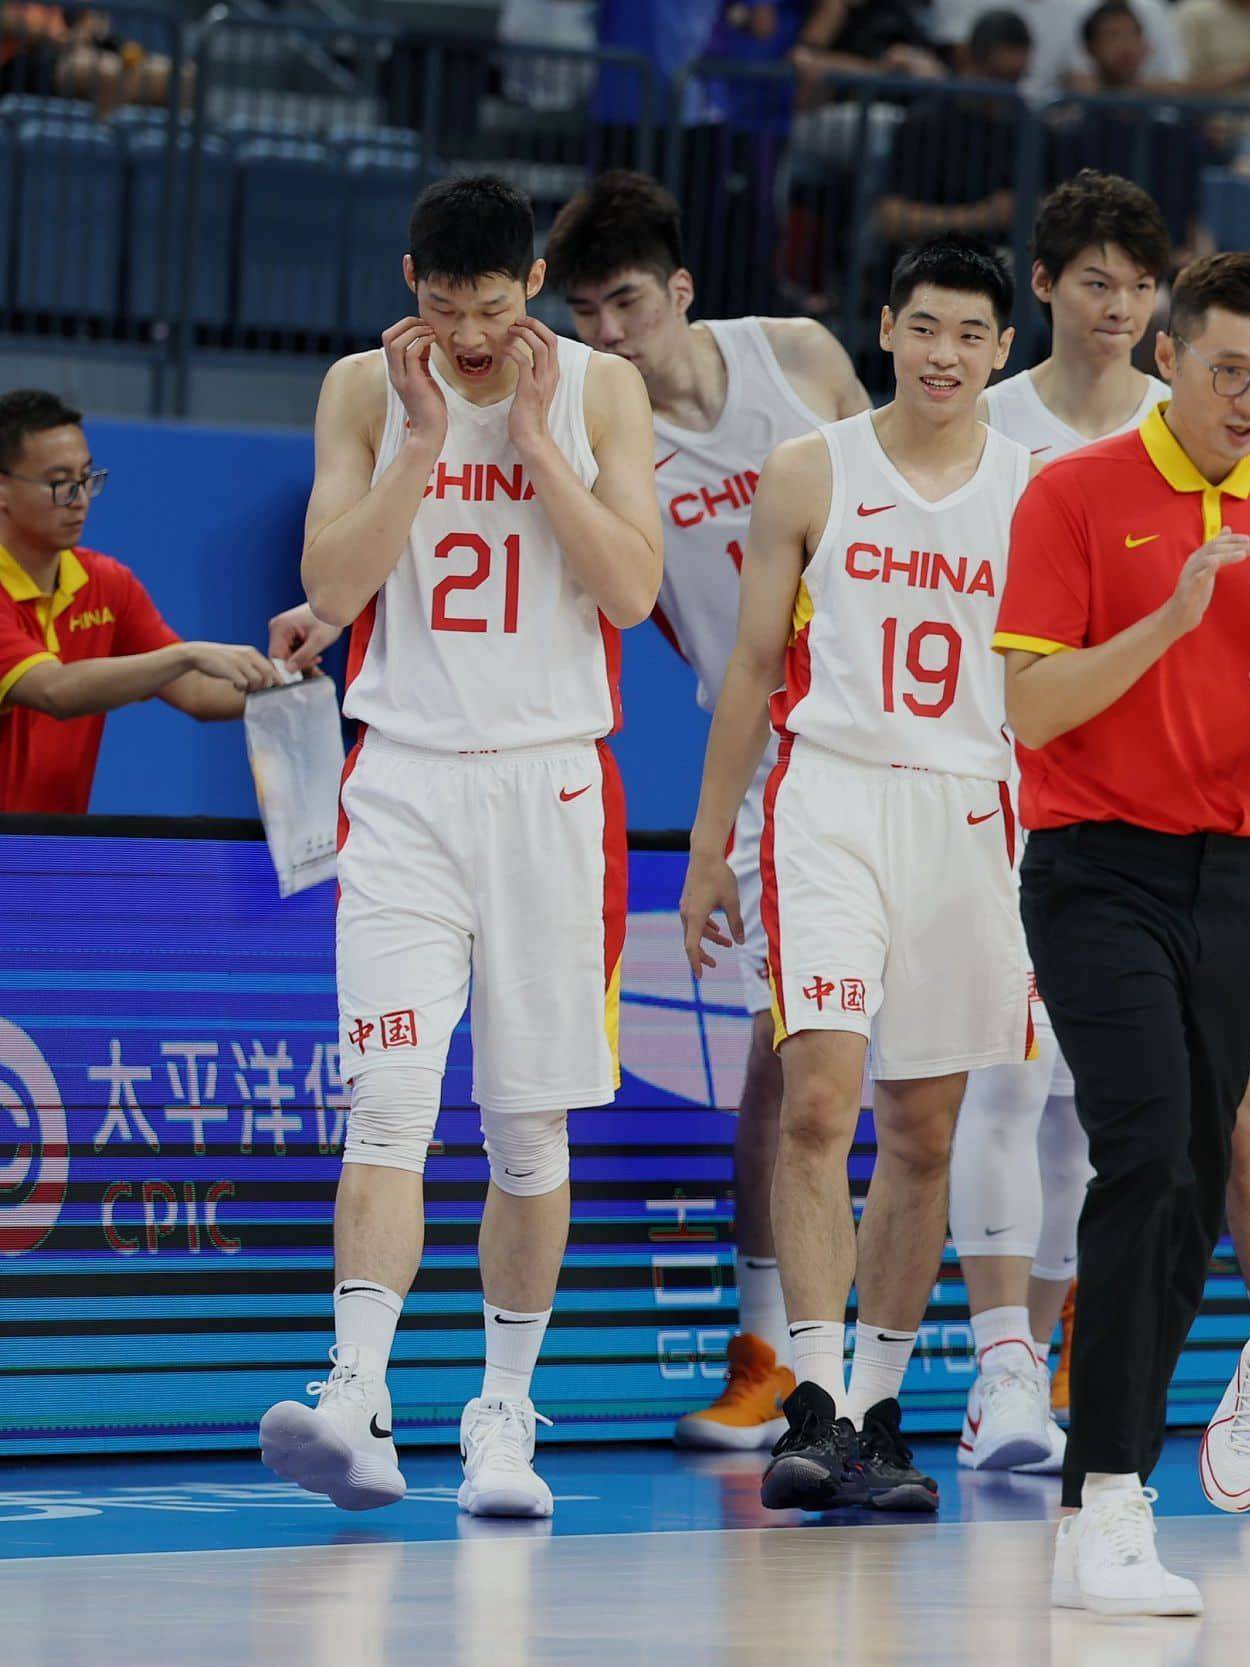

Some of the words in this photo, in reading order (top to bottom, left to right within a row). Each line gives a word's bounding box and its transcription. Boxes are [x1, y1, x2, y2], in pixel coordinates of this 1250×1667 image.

[431, 532, 521, 634] 21
[844, 542, 995, 598] CHINA
[69, 607, 115, 633] HINA
[881, 617, 963, 719] 19
[802, 975, 867, 1016] 中国
[347, 1009, 418, 1056] 中国
[87, 1037, 352, 1156] 太平洋保
[101, 1179, 242, 1255] CPIC
